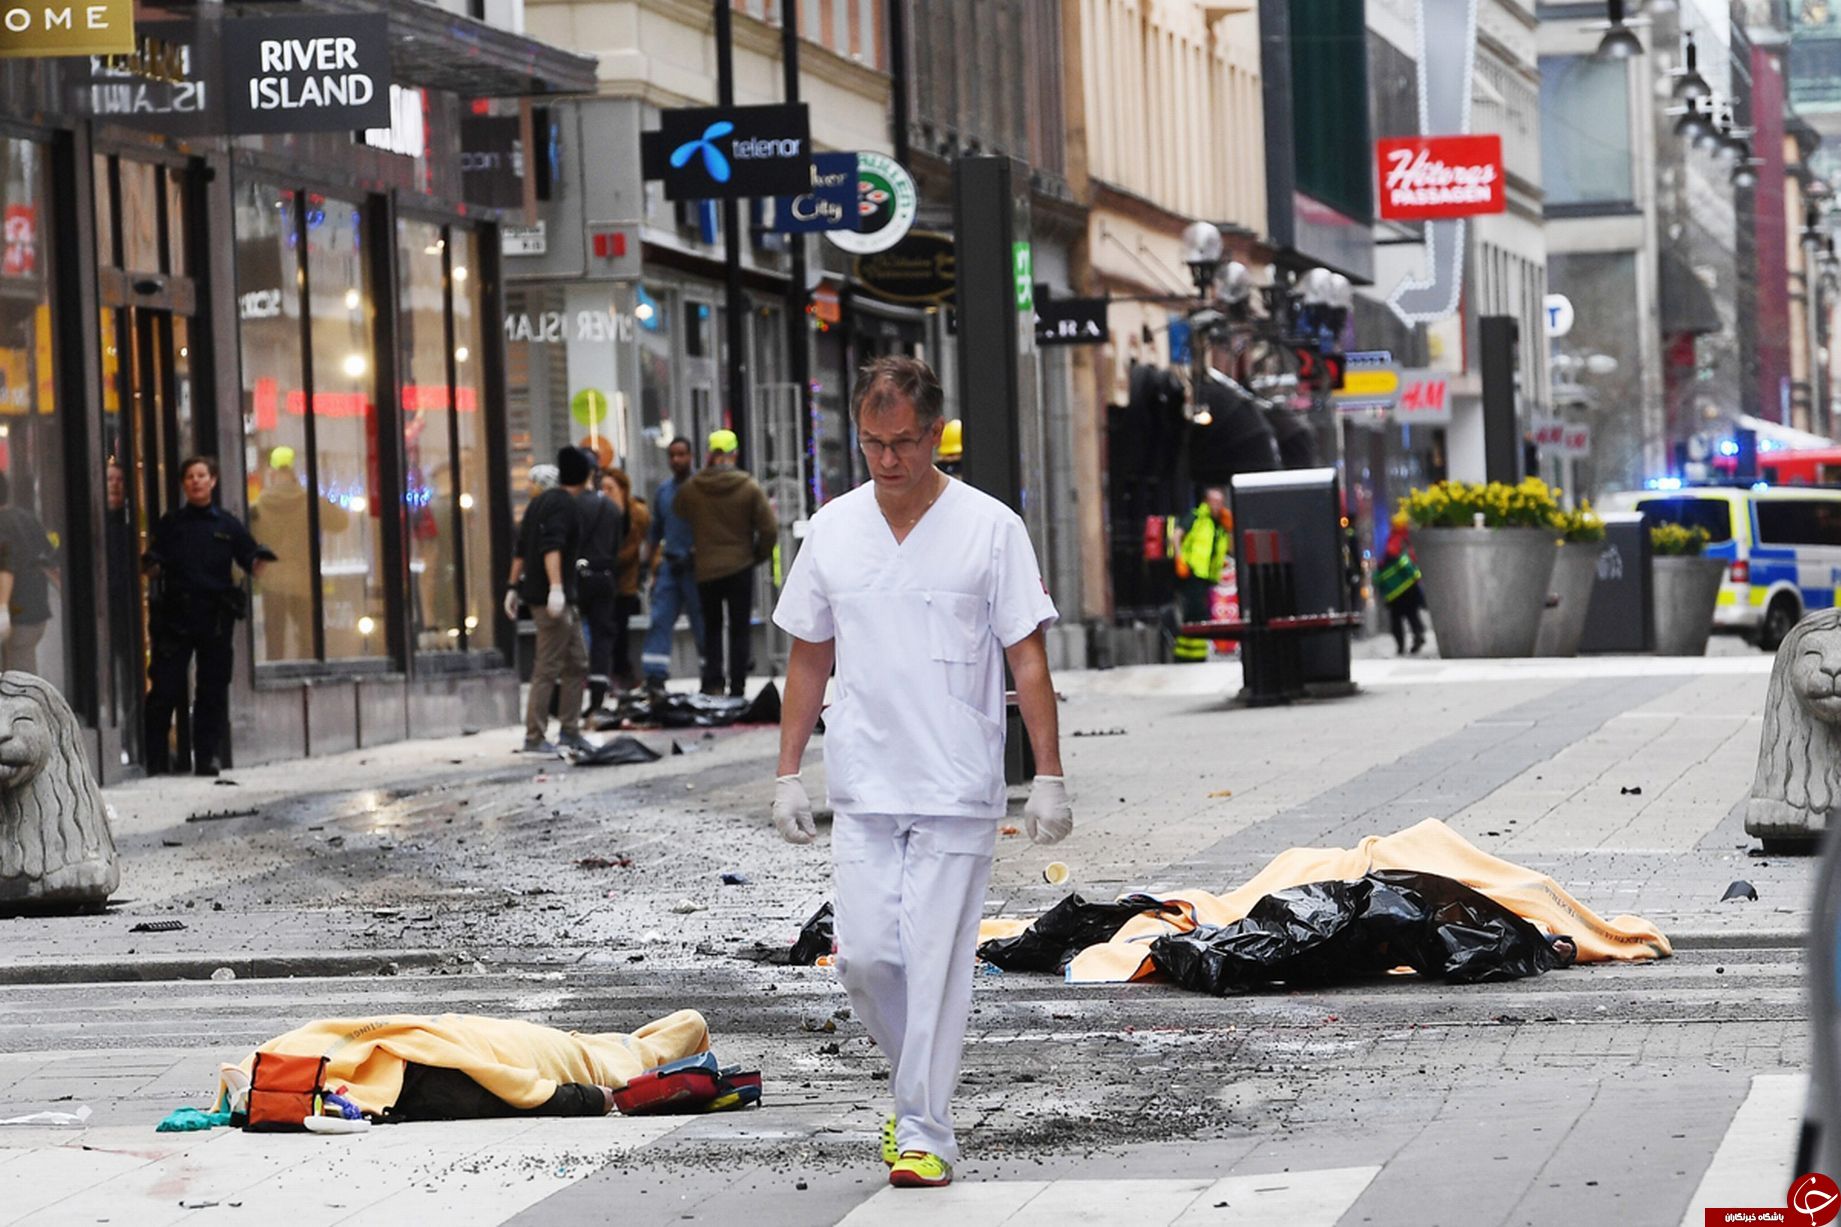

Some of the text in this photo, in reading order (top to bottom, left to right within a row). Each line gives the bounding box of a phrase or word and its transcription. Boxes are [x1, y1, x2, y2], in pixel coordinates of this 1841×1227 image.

[261, 37, 359, 72] RIVER
[249, 74, 374, 110] ISLAND
[732, 138, 801, 159] telenor
[791, 193, 843, 224] City
